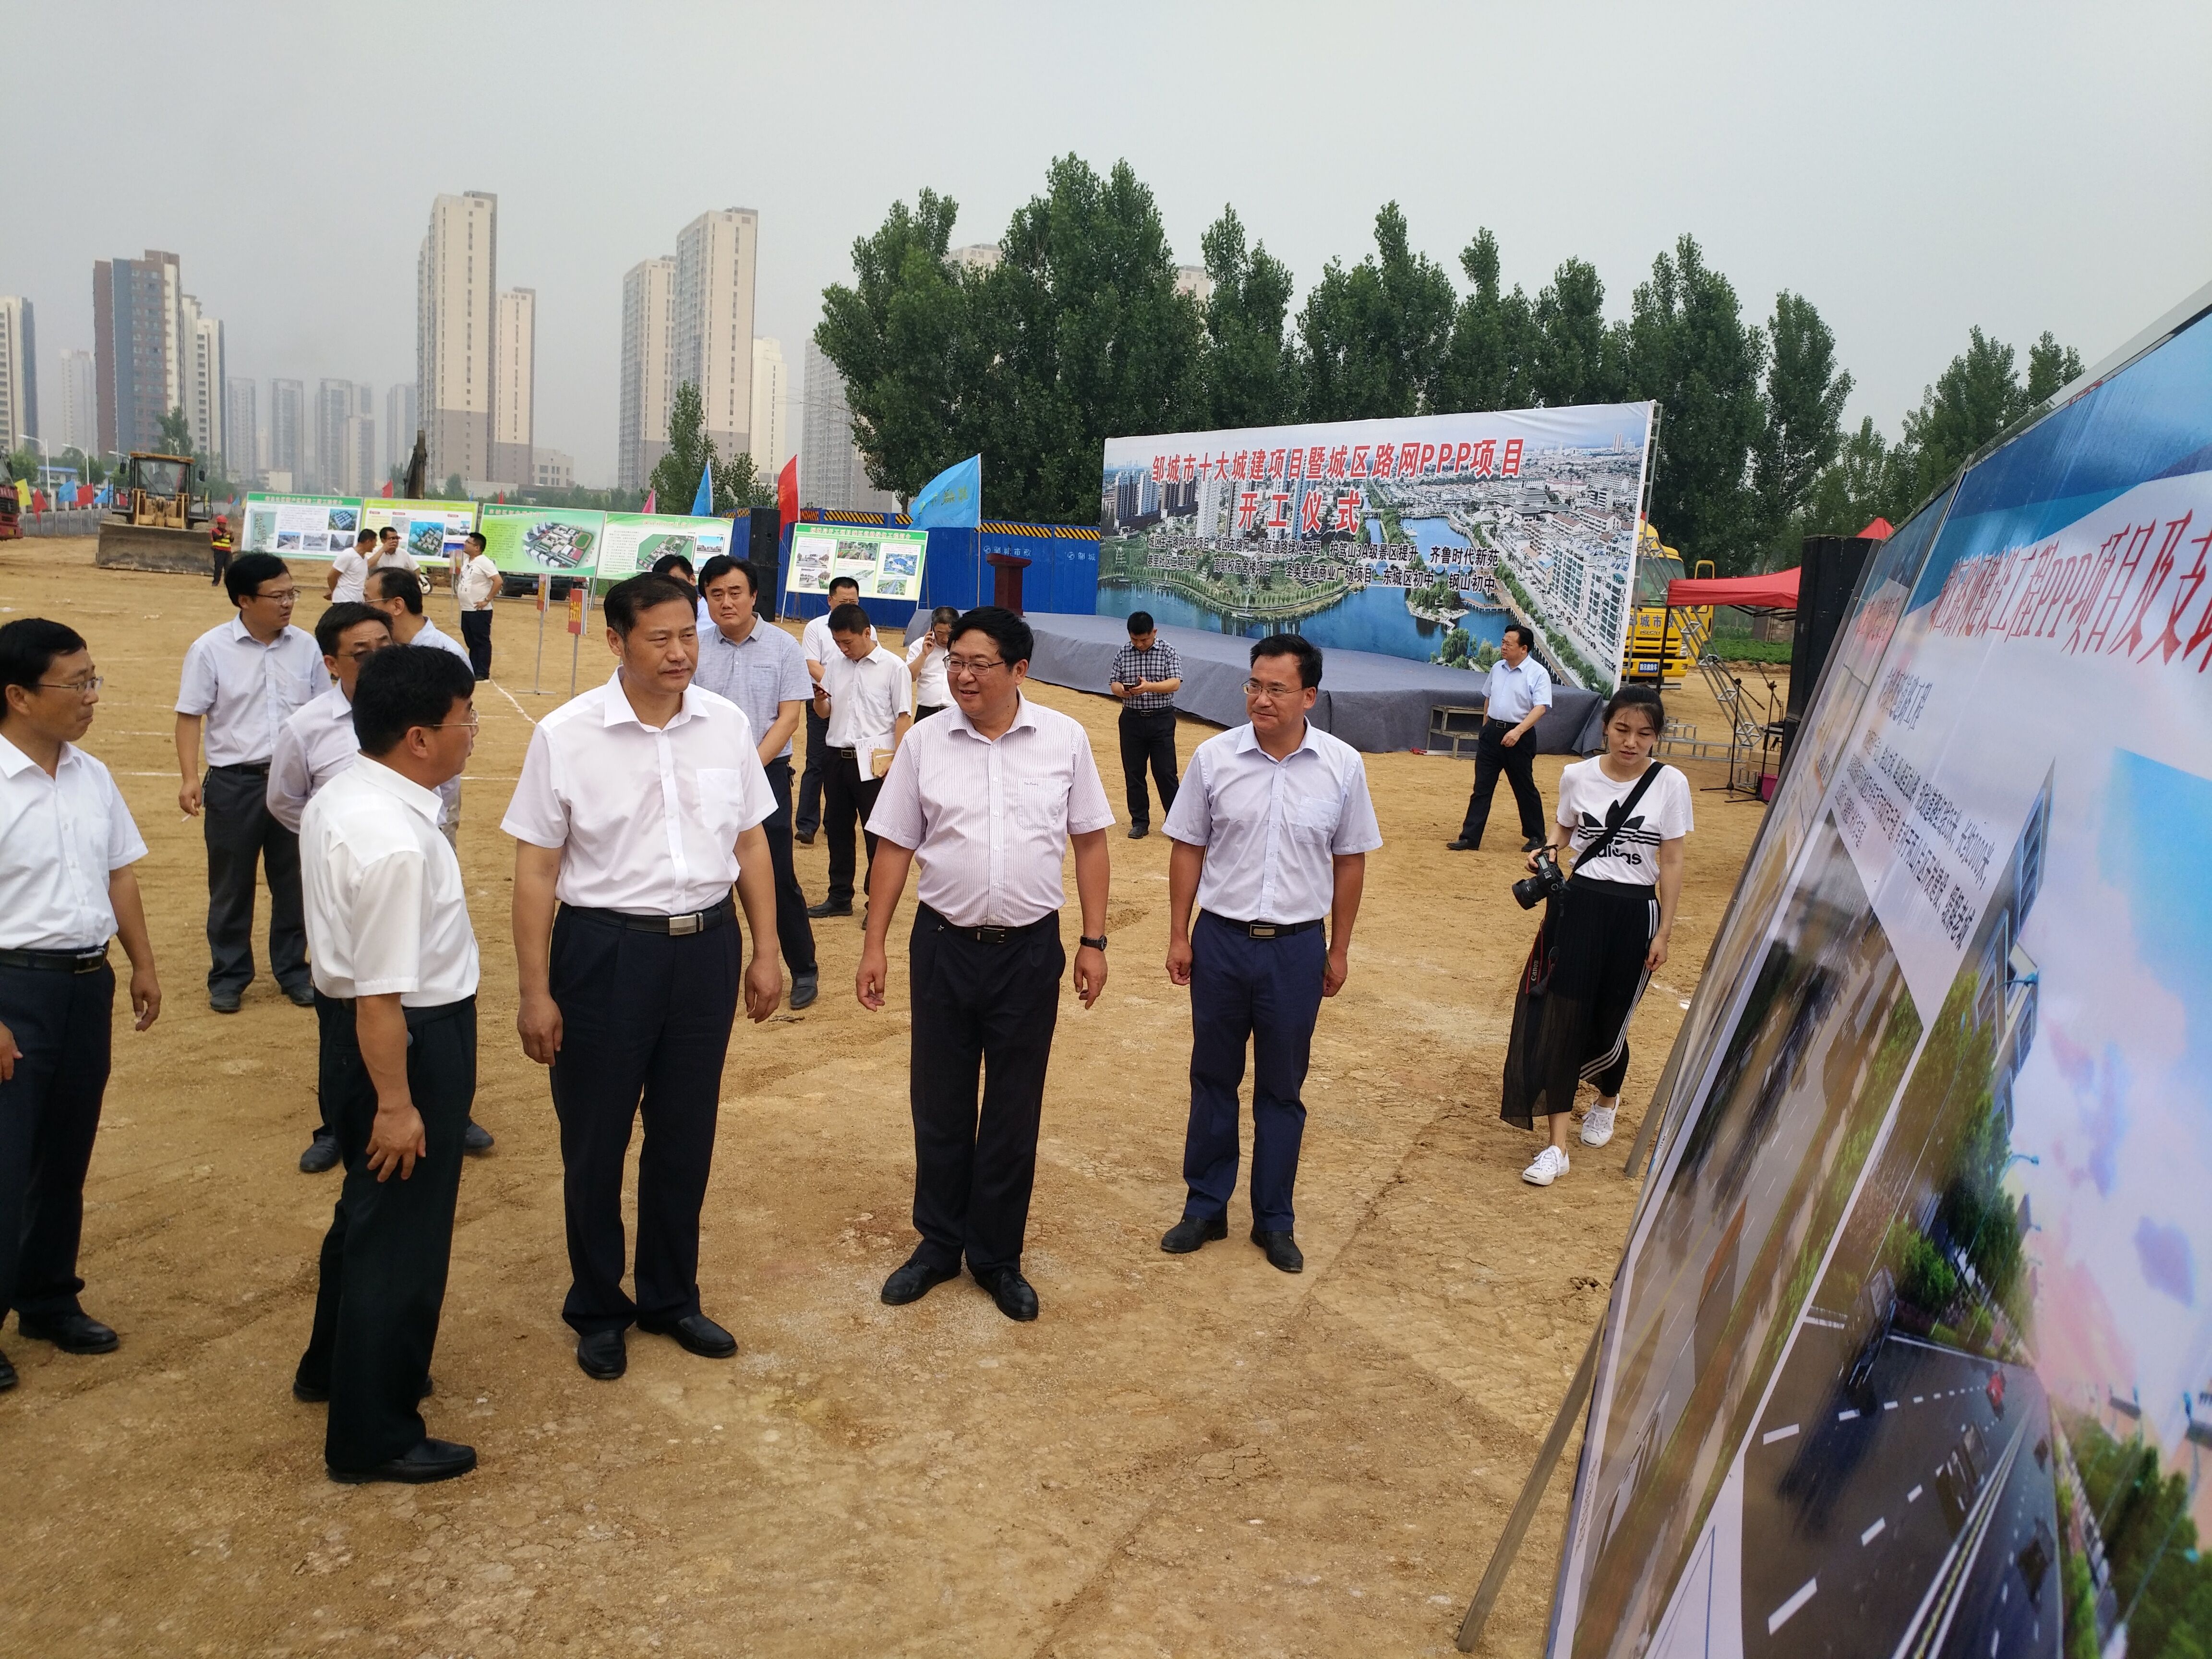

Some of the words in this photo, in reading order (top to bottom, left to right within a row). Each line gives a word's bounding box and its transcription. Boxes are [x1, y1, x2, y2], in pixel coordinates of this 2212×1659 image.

[1152, 439, 1524, 482] 邹城市十大城建项目暨城区路网PPP项目
[1238, 490, 1361, 534] 开工仪式
[1148, 536, 1209, 551] 城区主干路网PPP项目
[1215, 537, 1251, 552] 城区支路网
[1258, 539, 1321, 557] 城区道路绿化工程
[1330, 542, 1419, 563] 护驾山3A级景区提升
[1430, 545, 1500, 567] 齐鲁时代新苑
[1147, 554, 1197, 571] 巷里社区二期工程
[1214, 557, 1271, 577] 高职校宿舍楼项目
[1286, 562, 1371, 584] 圣奥金融商业广场项目
[1383, 568, 1434, 589] 东城区初中
[1449, 572, 1496, 594] 钢山初中
